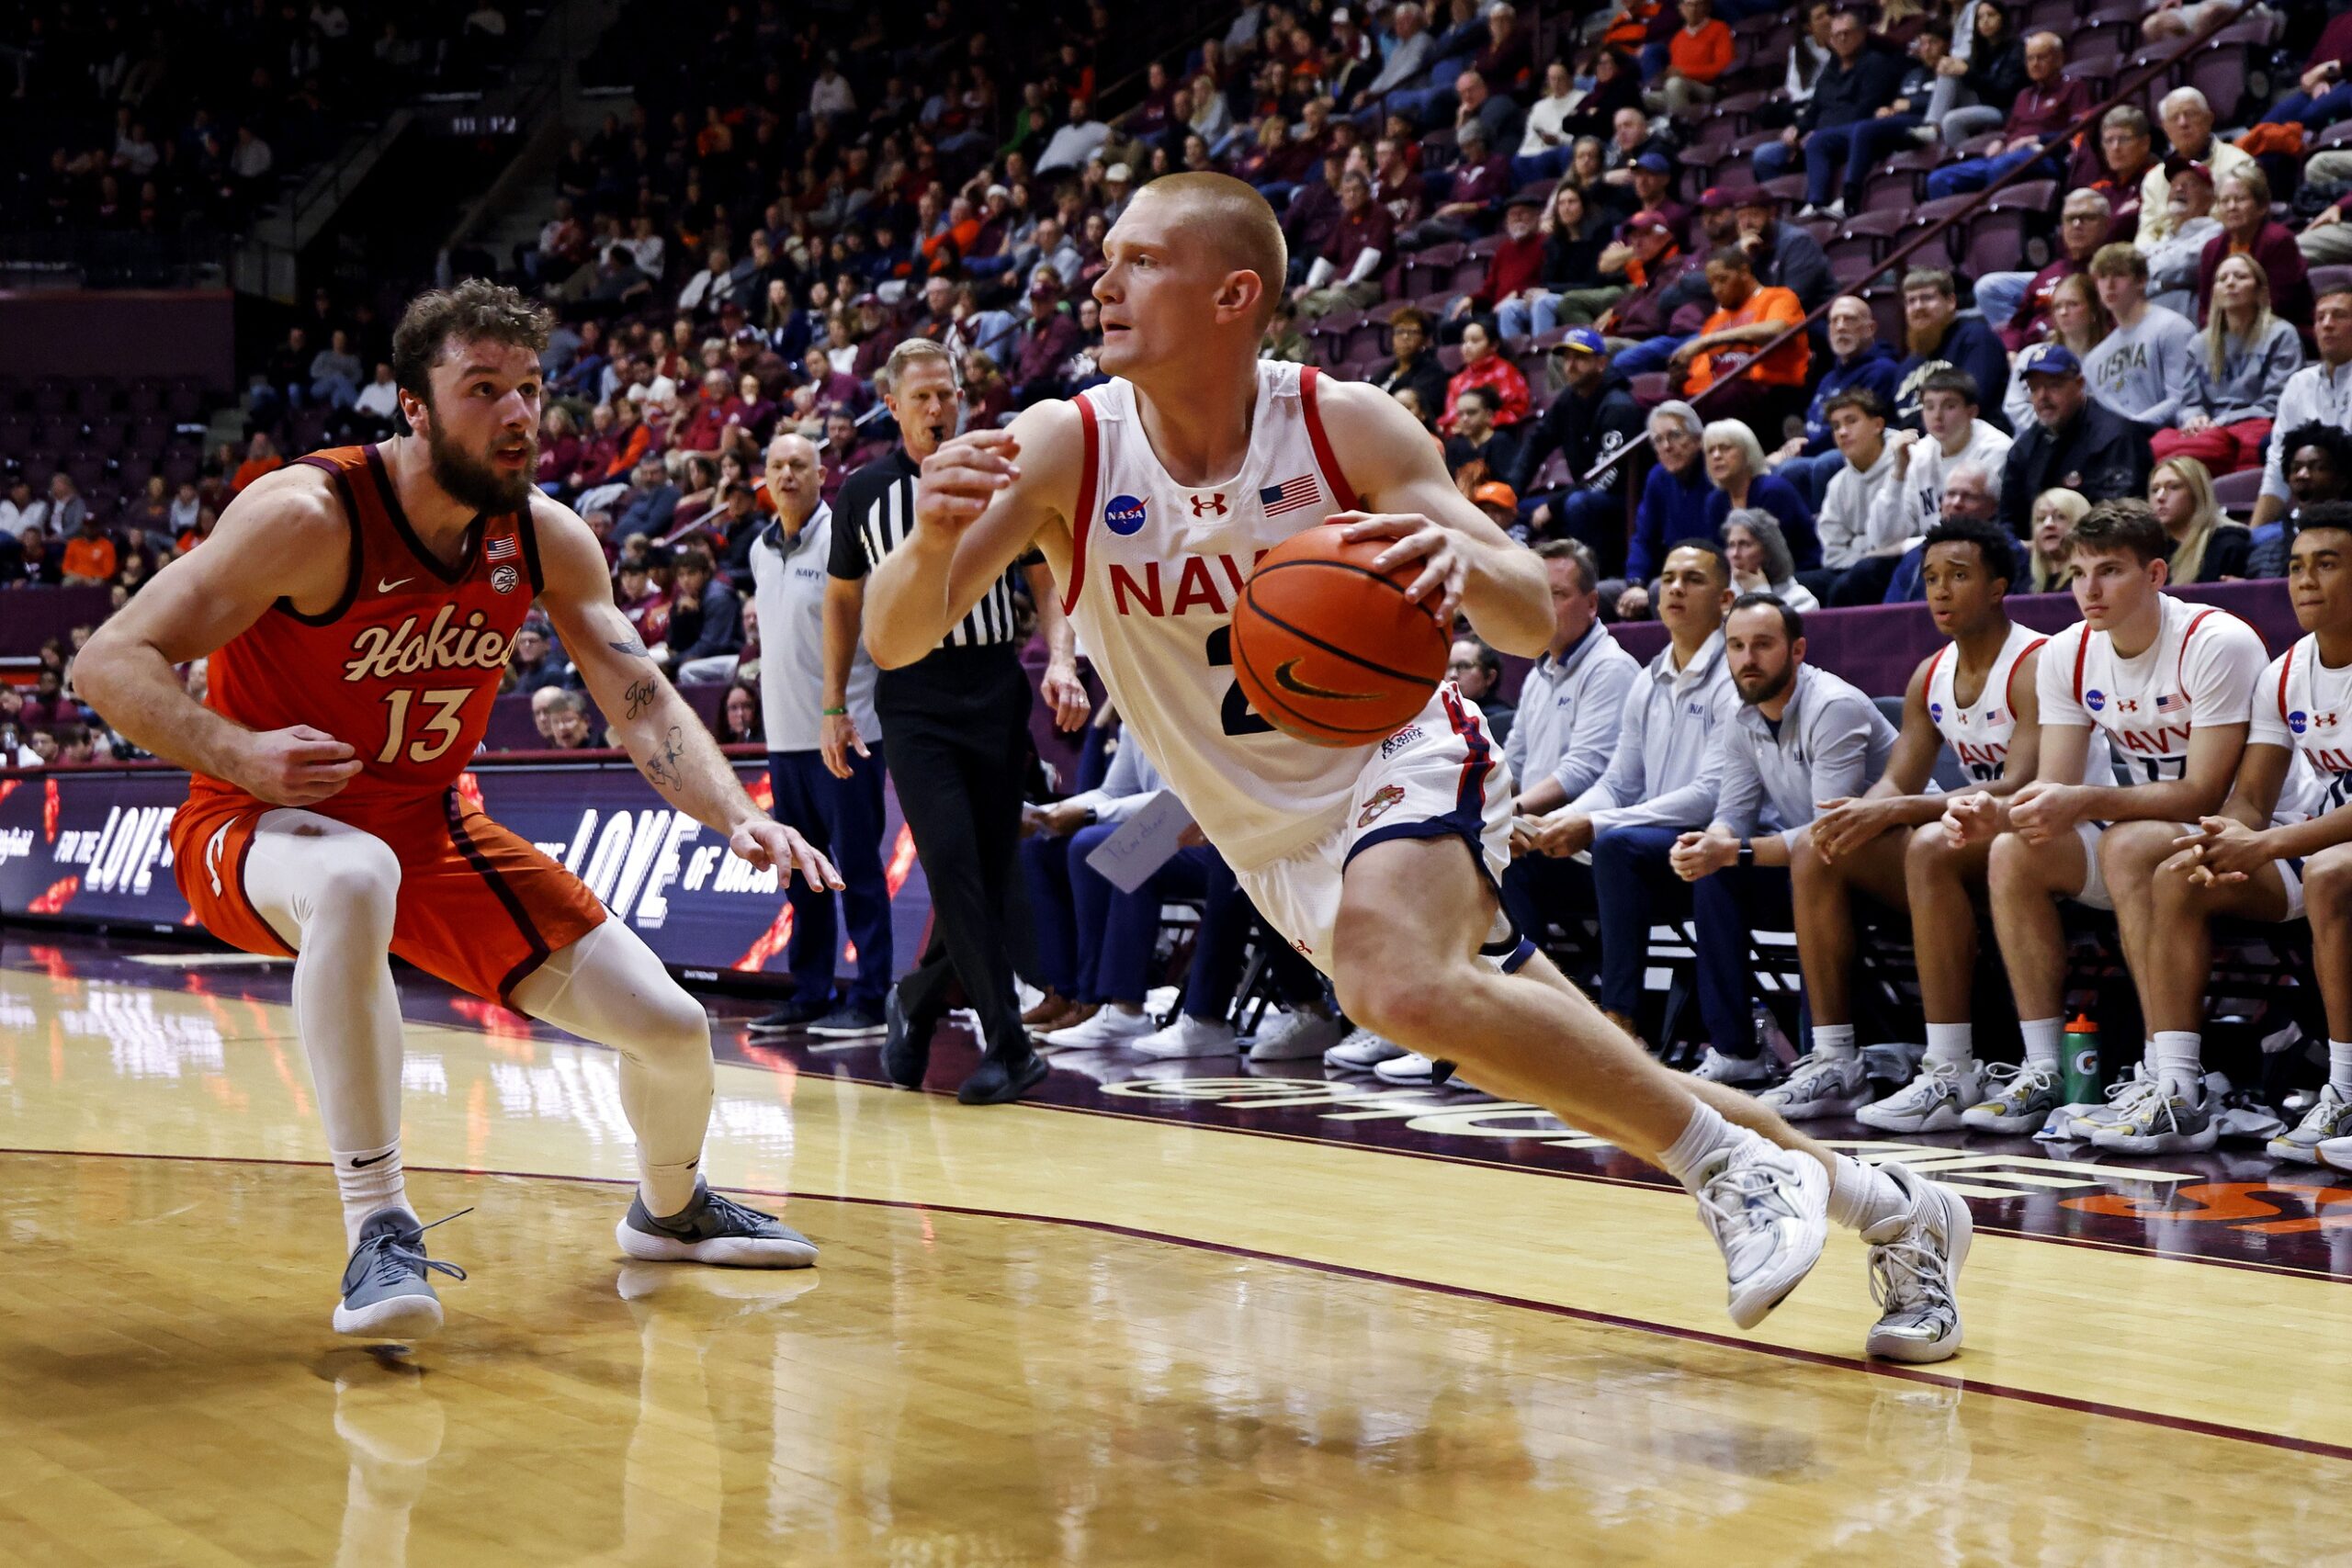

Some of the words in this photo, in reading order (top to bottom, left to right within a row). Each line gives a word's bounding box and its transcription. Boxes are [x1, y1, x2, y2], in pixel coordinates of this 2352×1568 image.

[1108, 510, 1144, 521] NASA
[796, 568, 822, 580] NAVY
[1108, 548, 1272, 617] NAV
[375, 687, 477, 765] 13
[625, 679, 658, 720] Joy
[85, 805, 177, 897] LOVE
[563, 808, 703, 929] LOVE
[682, 845, 723, 892] OF
